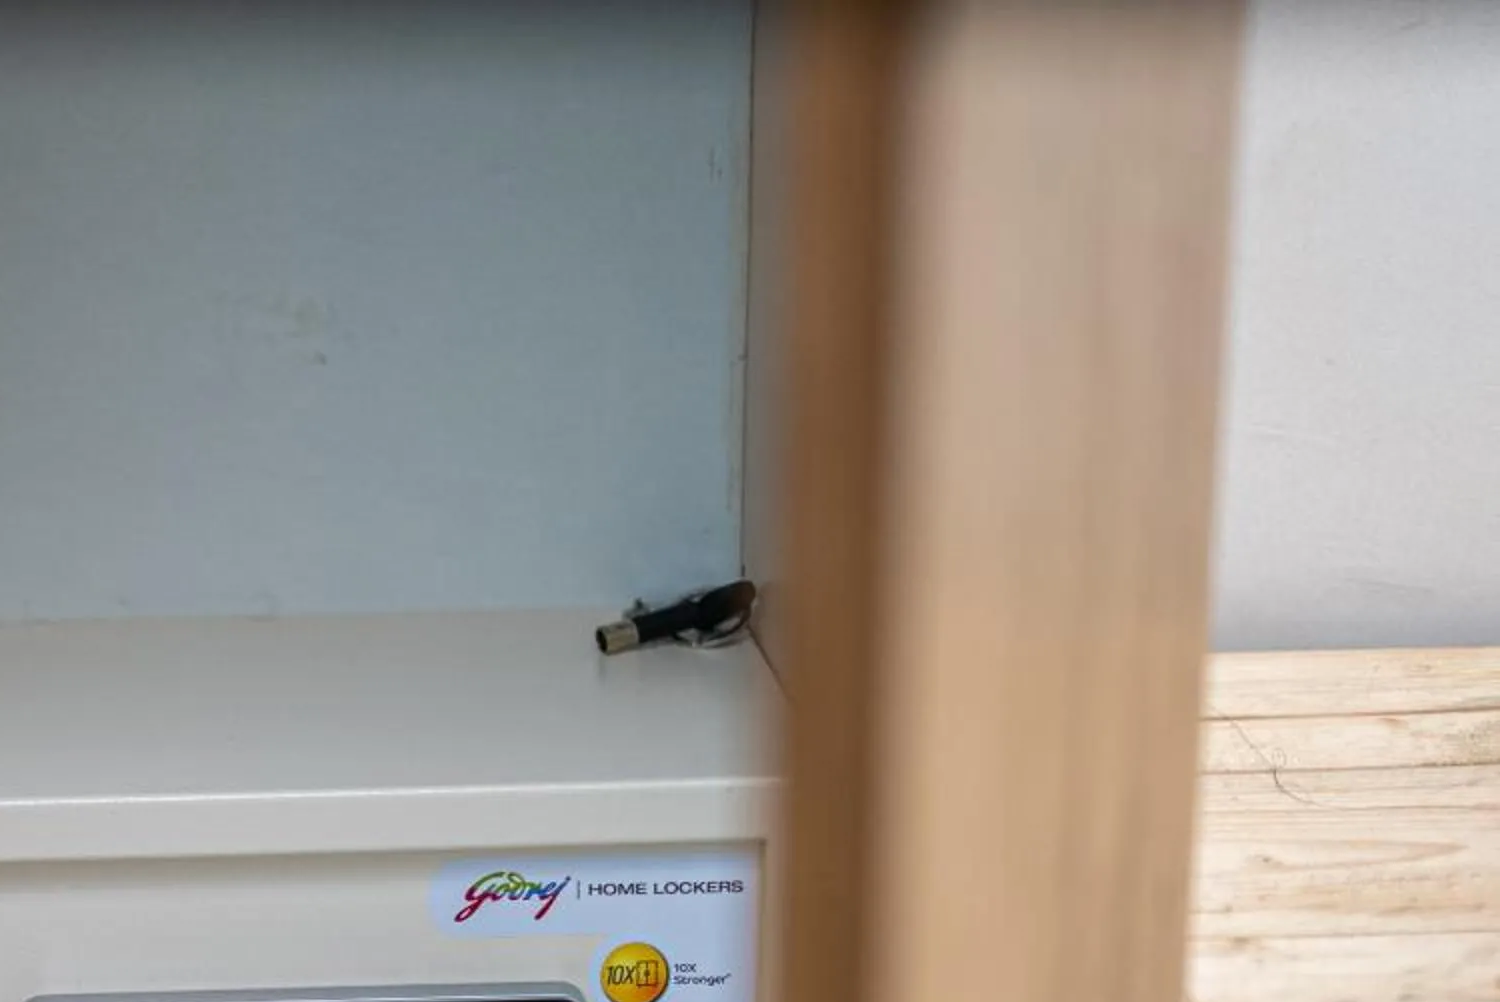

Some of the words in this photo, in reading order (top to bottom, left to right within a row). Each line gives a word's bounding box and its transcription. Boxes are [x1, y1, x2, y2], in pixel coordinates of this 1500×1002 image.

[454, 871, 572, 922] Godrej
[588, 882, 649, 896] HOME
[652, 880, 745, 895] LOCKERS
[606, 964, 636, 986] 10X
[673, 963, 697, 973] 10X
